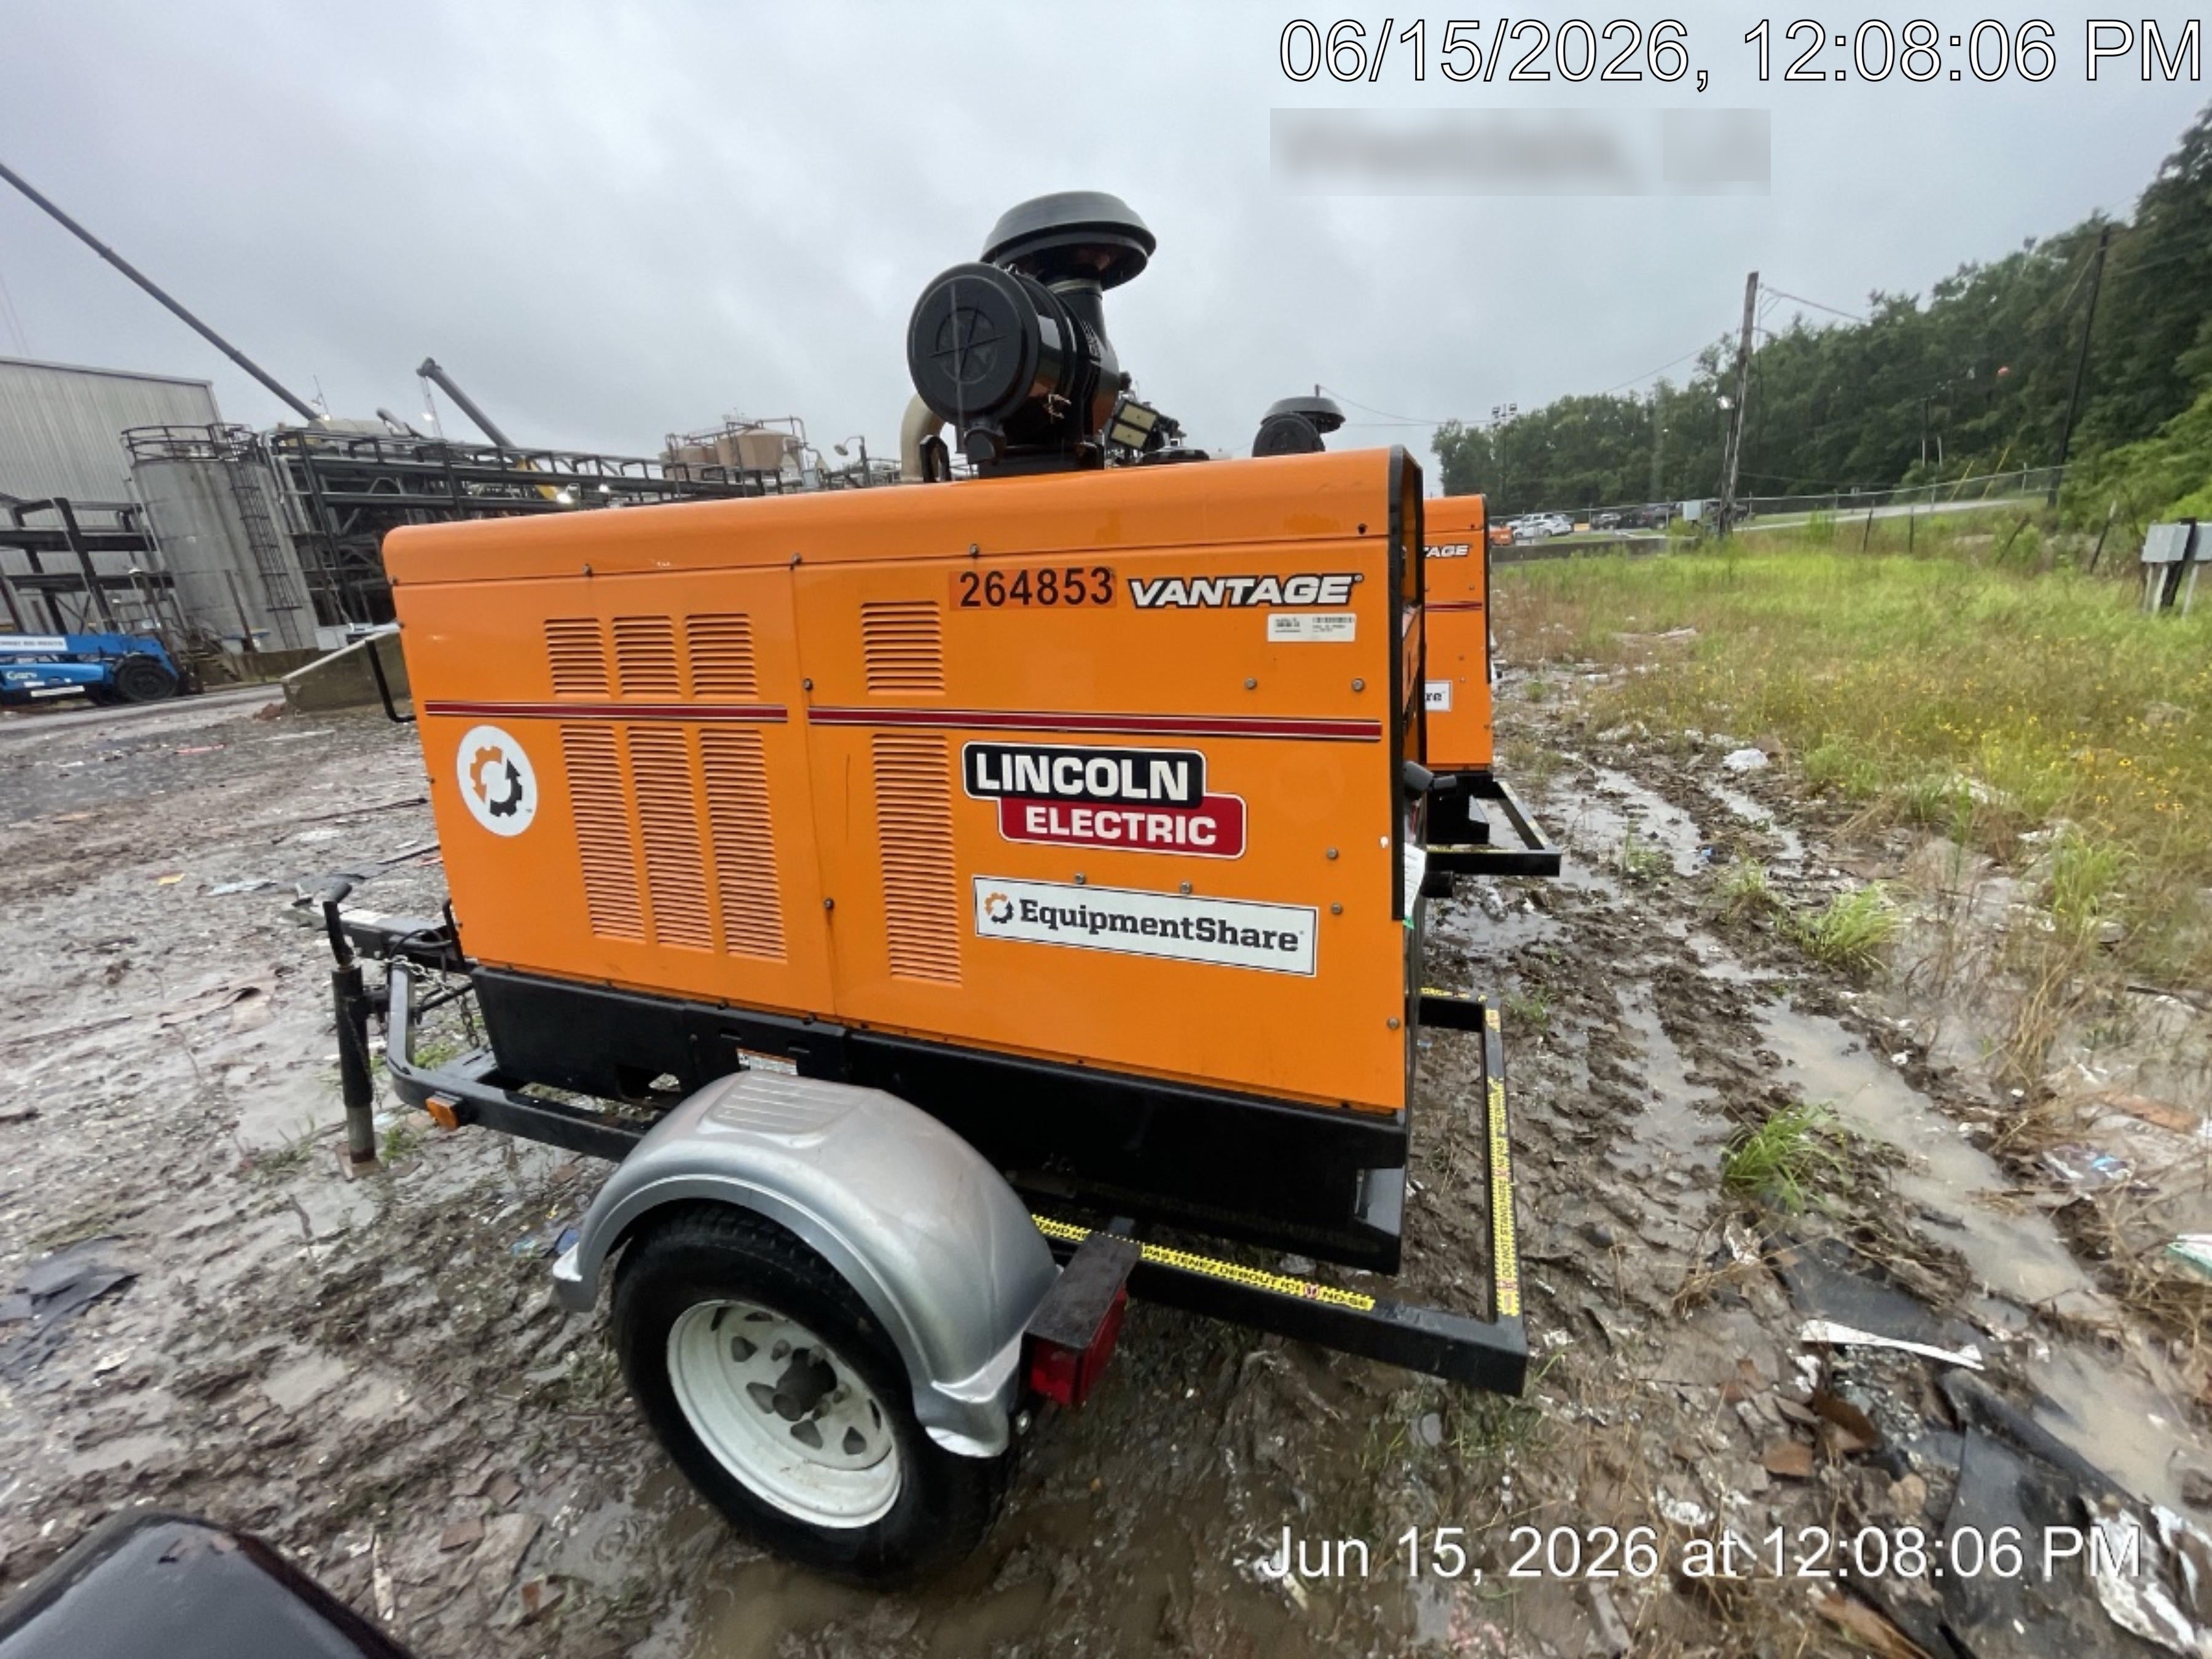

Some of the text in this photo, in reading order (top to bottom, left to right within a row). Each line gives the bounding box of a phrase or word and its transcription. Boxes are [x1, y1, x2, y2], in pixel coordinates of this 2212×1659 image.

[960, 566, 1113, 607] 264853
[976, 753, 1188, 801] LINCOLN
[1026, 806, 1217, 845] ELECTRIC
[1019, 898, 1299, 952] EquipmentShare
[1500, 1237, 1510, 1260] NOT
